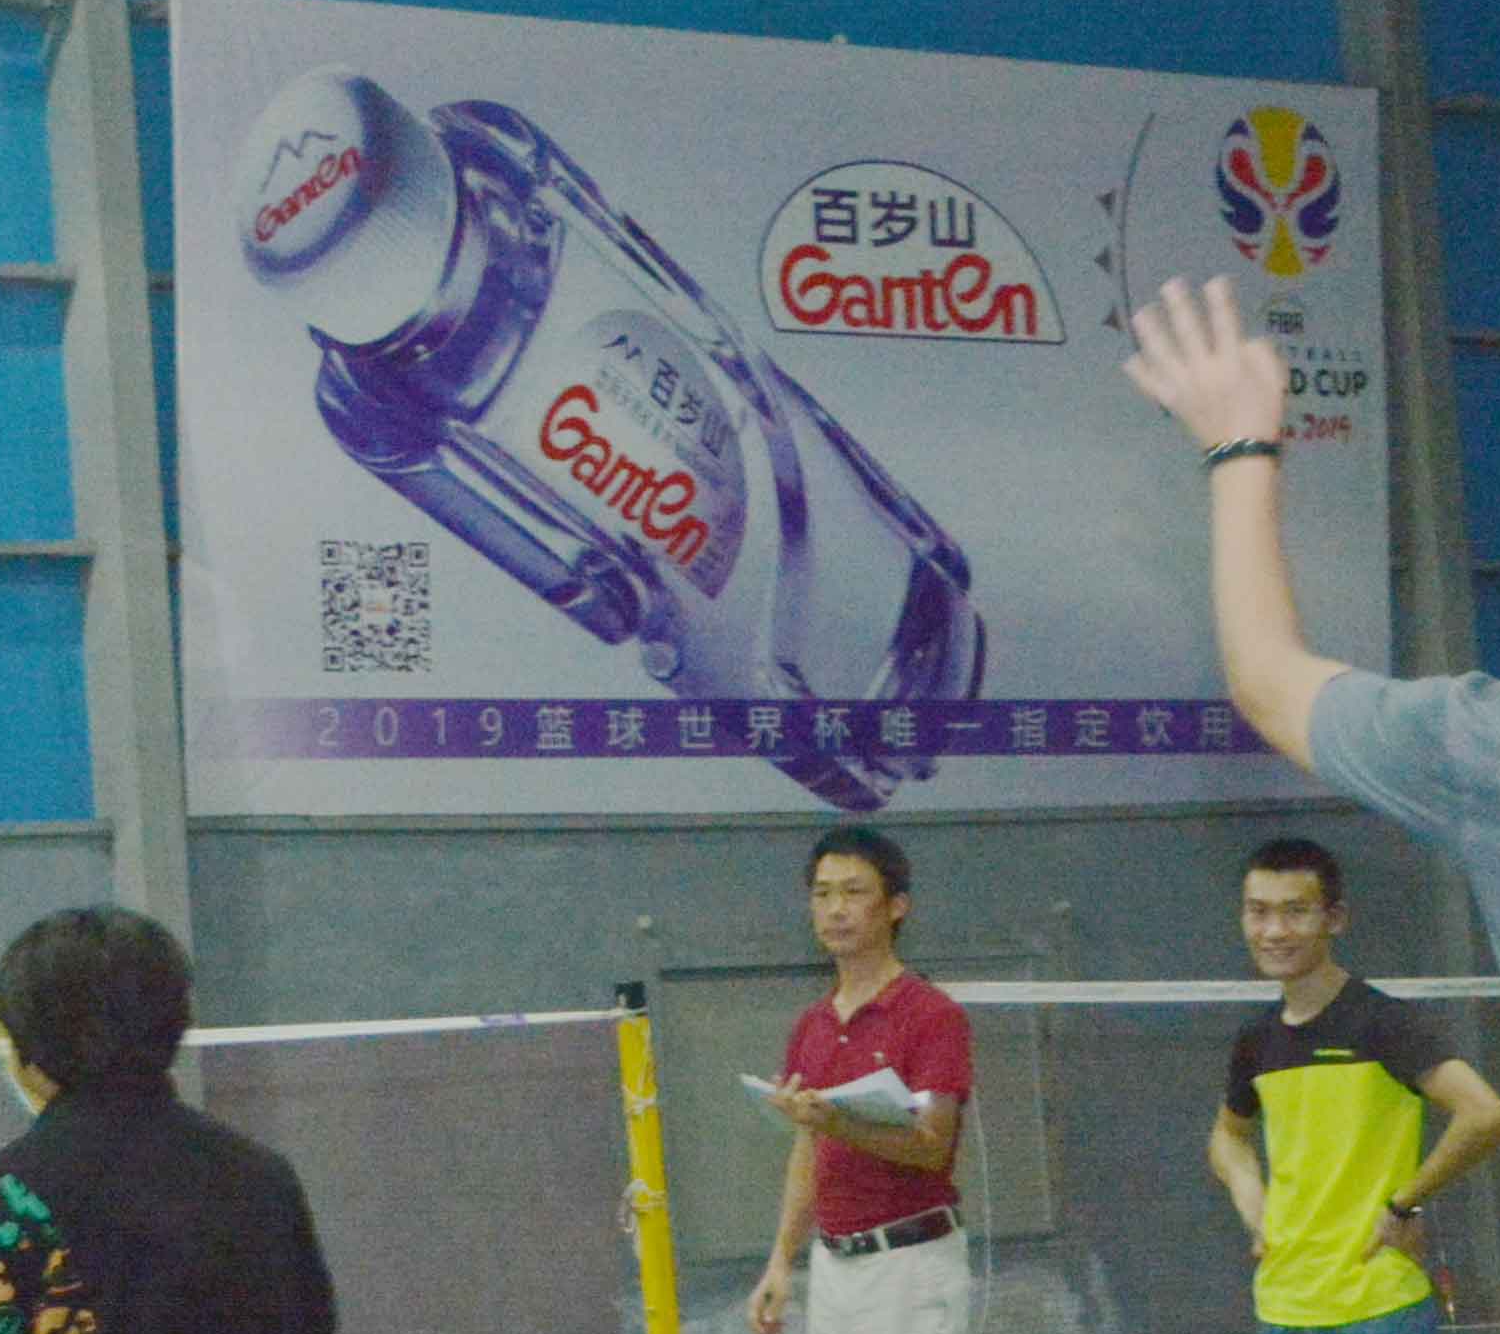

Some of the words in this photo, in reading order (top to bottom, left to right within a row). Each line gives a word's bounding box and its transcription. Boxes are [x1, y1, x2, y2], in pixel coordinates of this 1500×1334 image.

[811, 187, 977, 250] 百岁山
[779, 243, 1038, 337] Ganten
[1314, 368, 1368, 398] CUP
[1303, 411, 1353, 443] 2019
[538, 383, 710, 566] Ganten
